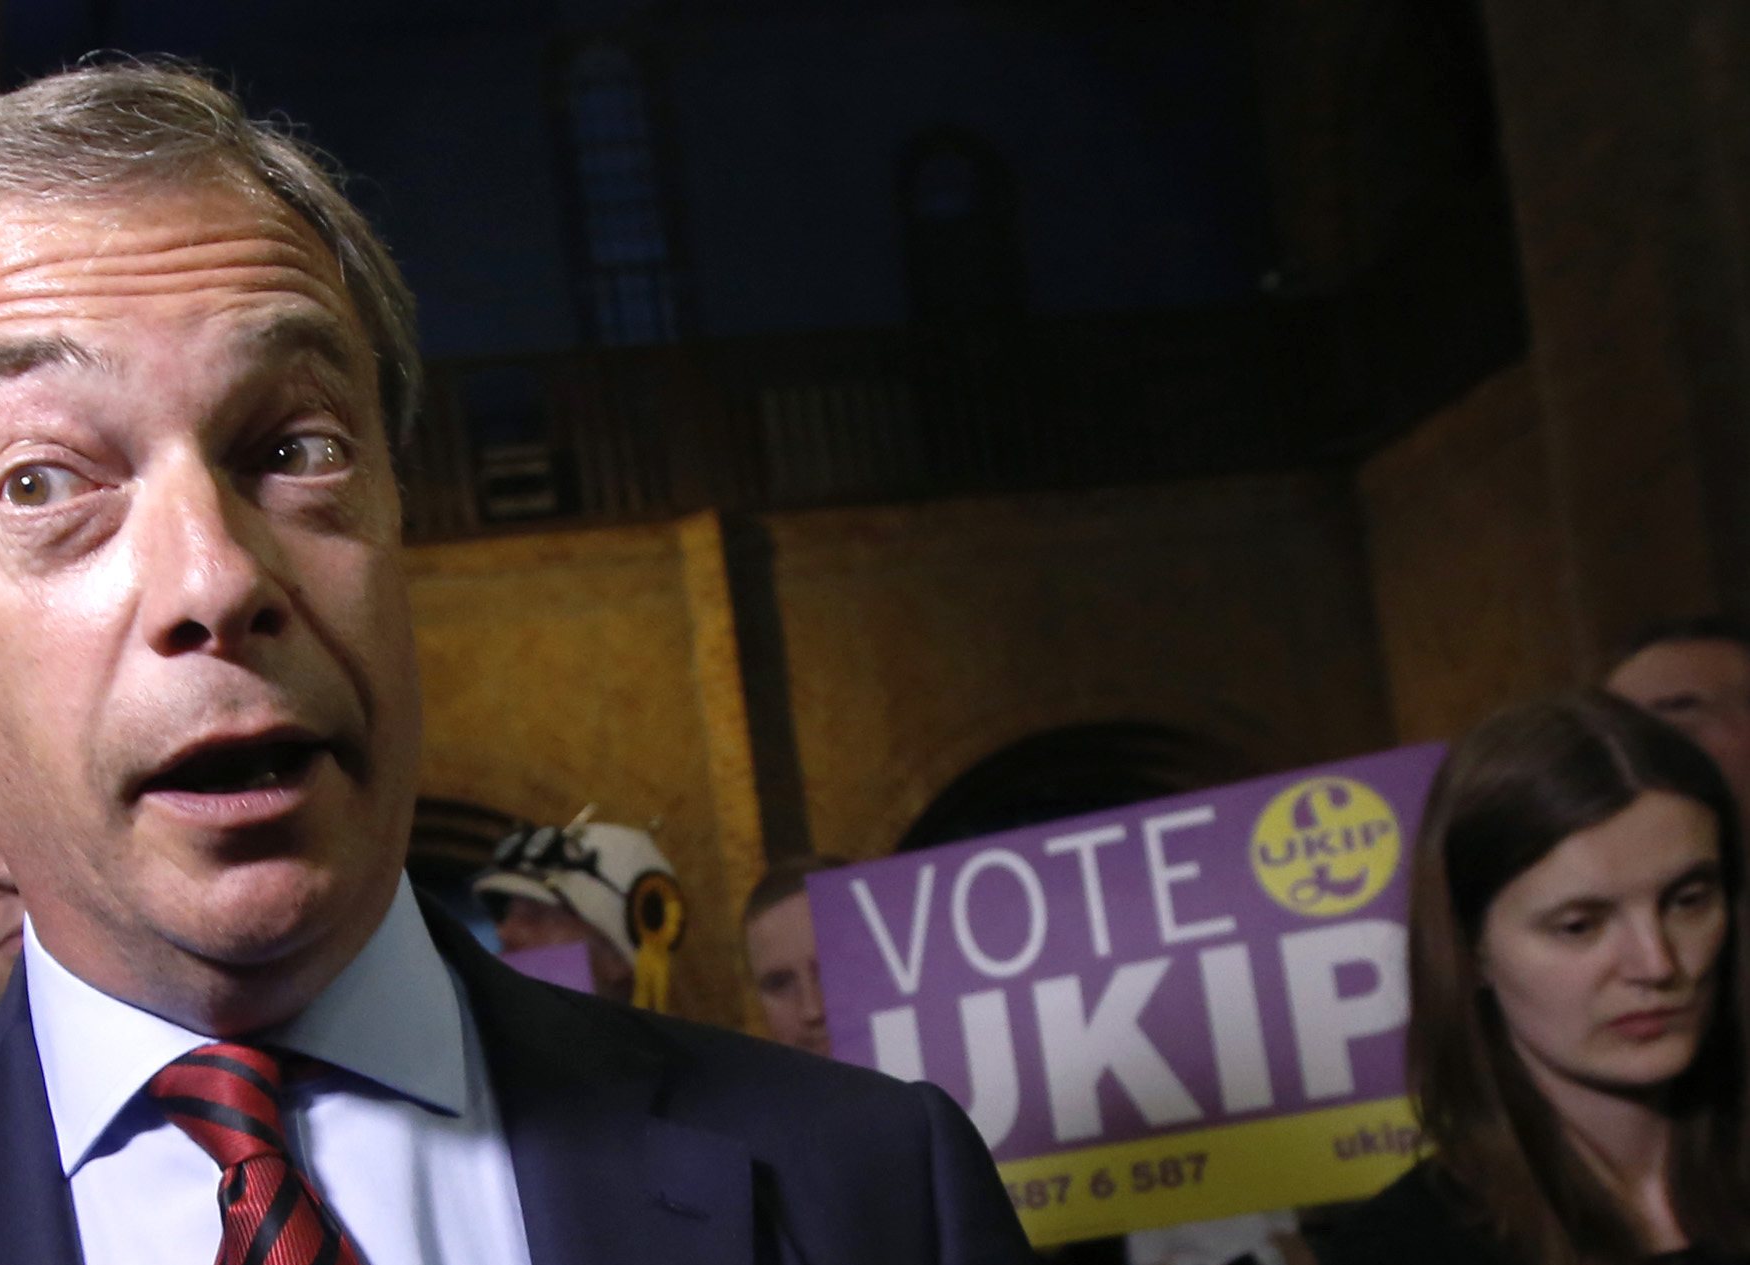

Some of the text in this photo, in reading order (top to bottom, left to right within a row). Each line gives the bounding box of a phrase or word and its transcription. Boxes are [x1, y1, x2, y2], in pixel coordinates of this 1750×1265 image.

[850, 805, 1237, 996] VOTE
[1259, 820, 1391, 869] UKIP
[869, 918, 1411, 1158] UKIP
[1089, 1167, 1117, 1199] 6
[1130, 1151, 1209, 1193] 587
